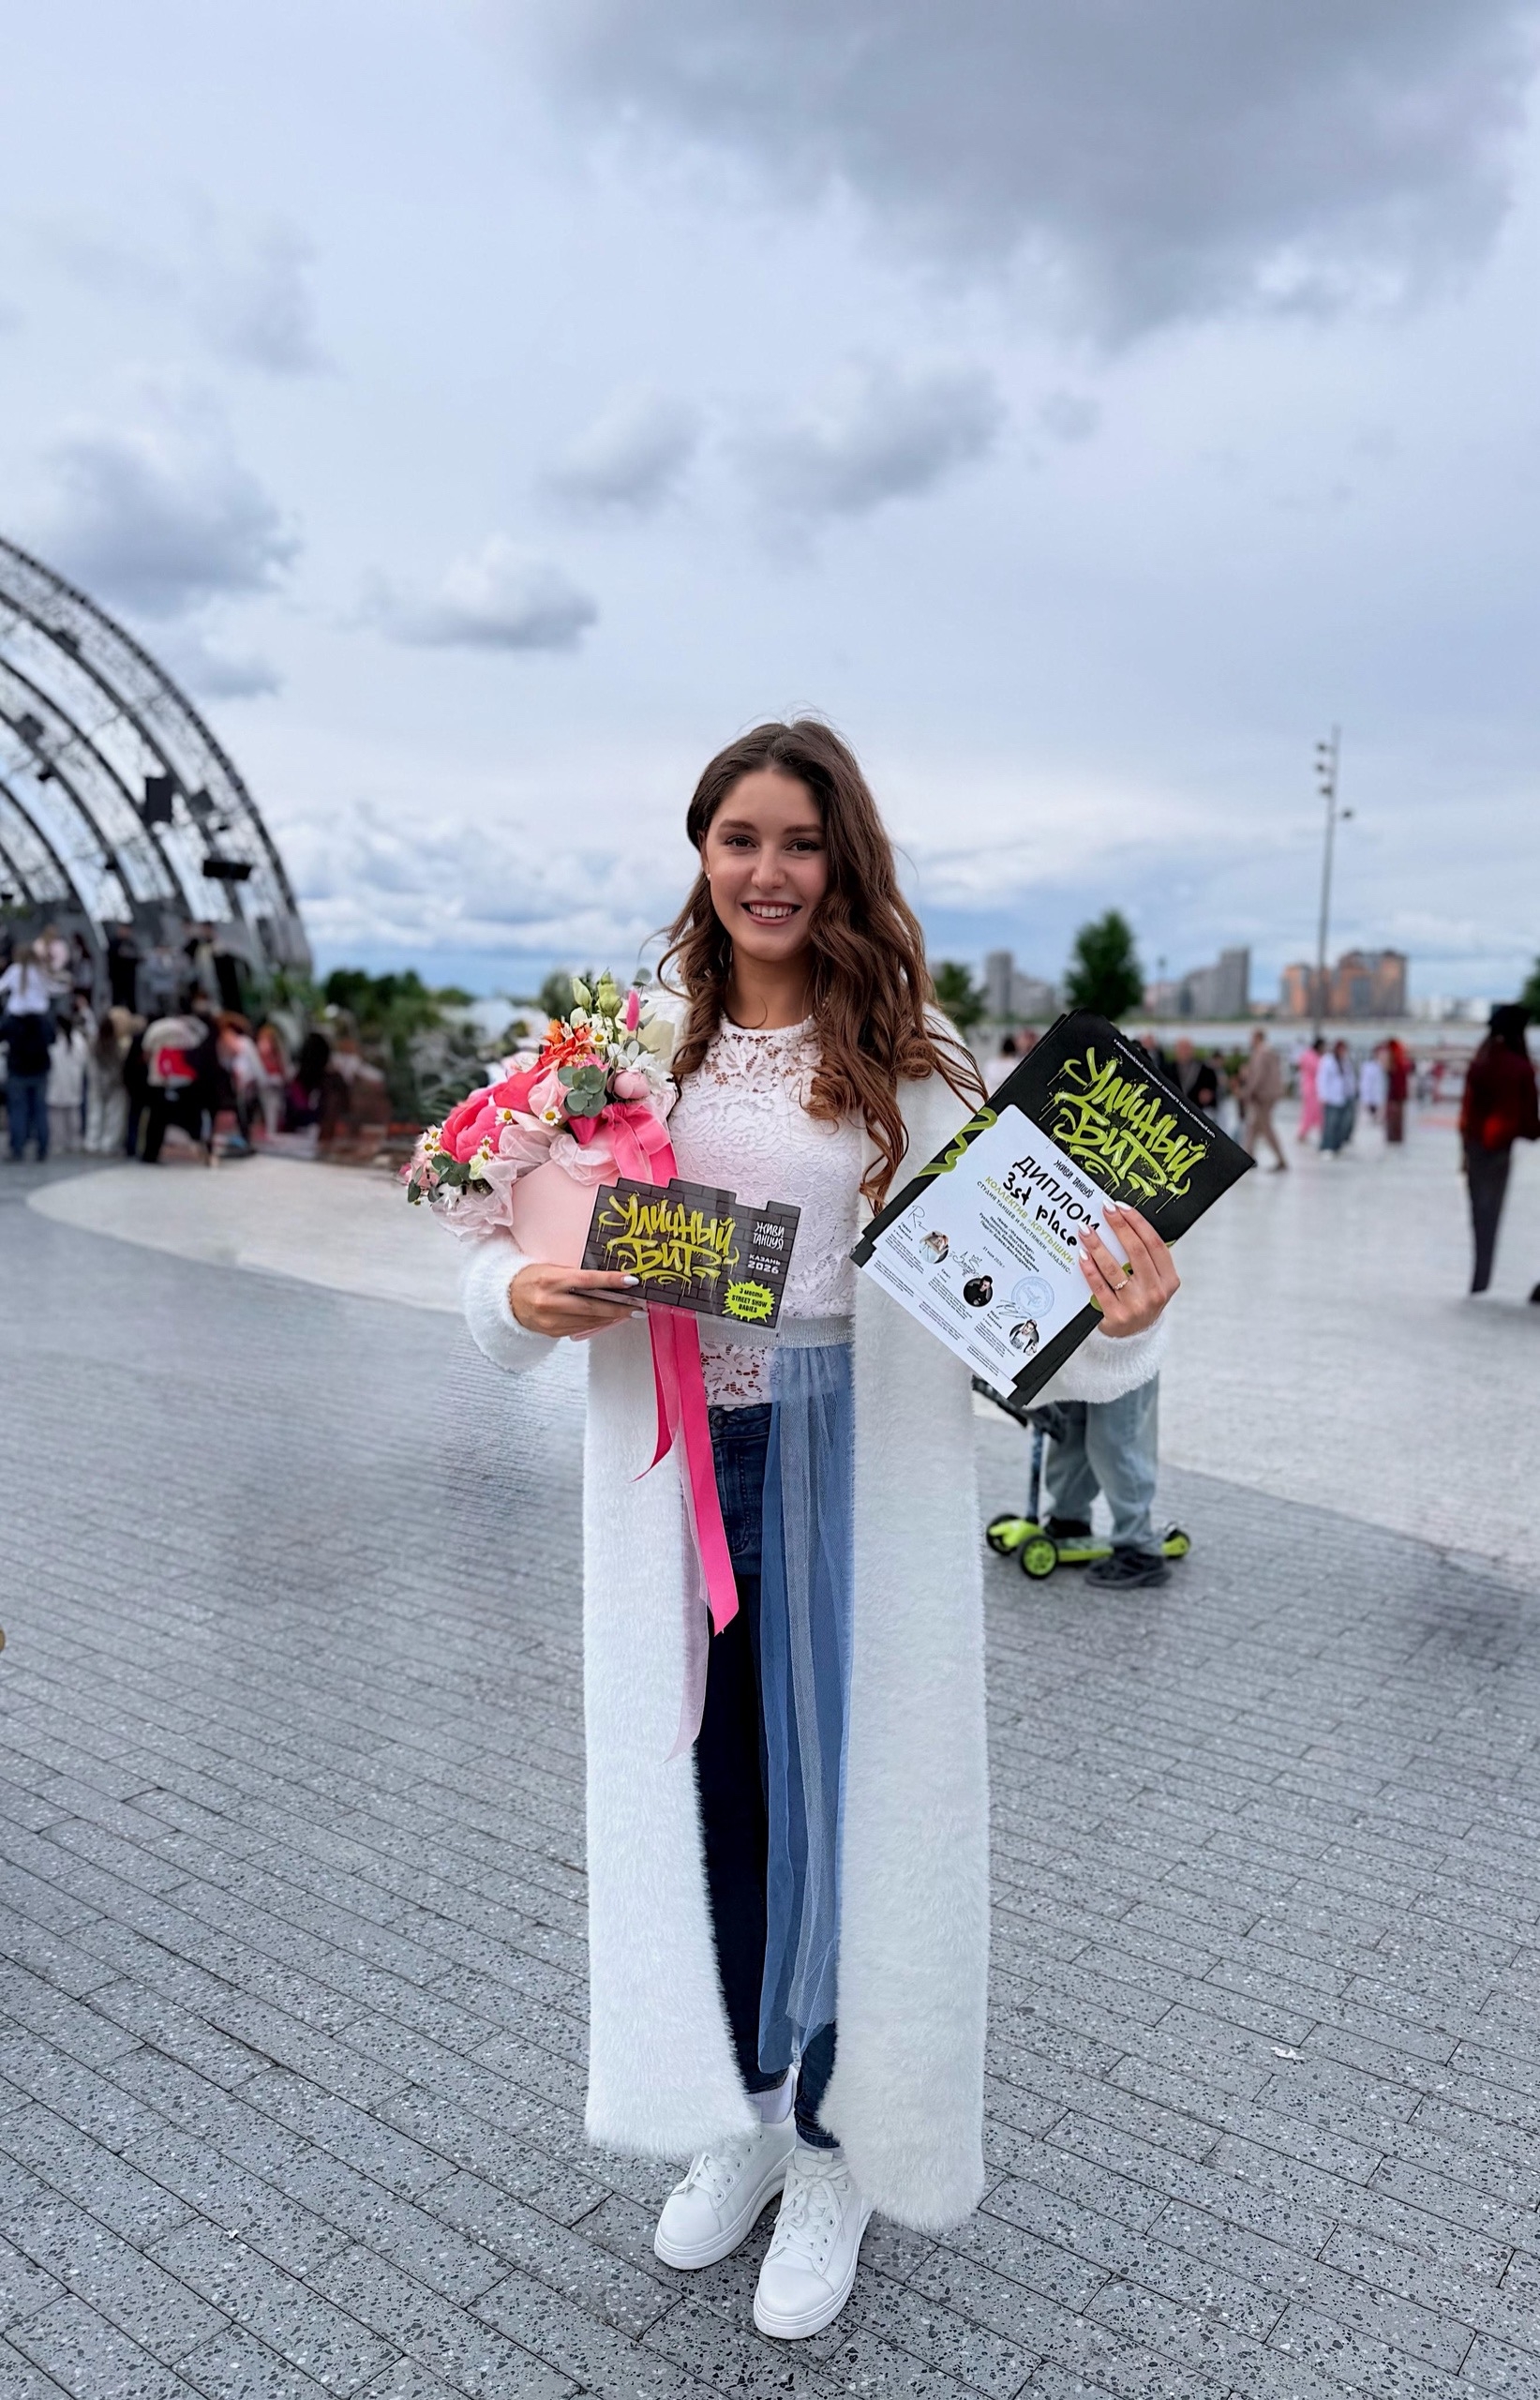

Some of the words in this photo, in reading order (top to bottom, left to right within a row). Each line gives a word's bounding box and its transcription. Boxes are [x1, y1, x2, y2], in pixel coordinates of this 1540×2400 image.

[1059, 1047, 1206, 1187] УЛИЧНЫЙ
[1054, 1095, 1167, 1185] БИТ
[1012, 1156, 1100, 1231] ДИПЛОМ
[1053, 1160, 1073, 1178] ЖИВИ
[1071, 1177, 1094, 1198] ТАНЦУЯ
[599, 1193, 737, 1257] УЛИЧНЫЙ
[977, 1181, 996, 1200] СТУДИЯ
[995, 1199, 1015, 1219] ТАНЦЕВ
[1019, 1222, 1046, 1249] РАСТЯЖКИ
[985, 1176, 1027, 1219] КОЛЛЕКТИВ
[1027, 1218, 1075, 1266] «КРУТЫШКИ»
[1002, 1171, 1031, 1206] 3st
[1036, 1205, 1077, 1246] place
[753, 1233, 784, 1251] ТАНЦУЯ
[755, 1222, 785, 1238] ЖИВИ
[608, 1238, 723, 1278] БИТ
[748, 1261, 779, 1274] 2026
[749, 1254, 781, 1266] КАЗАНЬ
[732, 1295, 751, 1304] STREET
[752, 1298, 767, 1308] SHOW
[739, 1303, 757, 1313] BABIES
